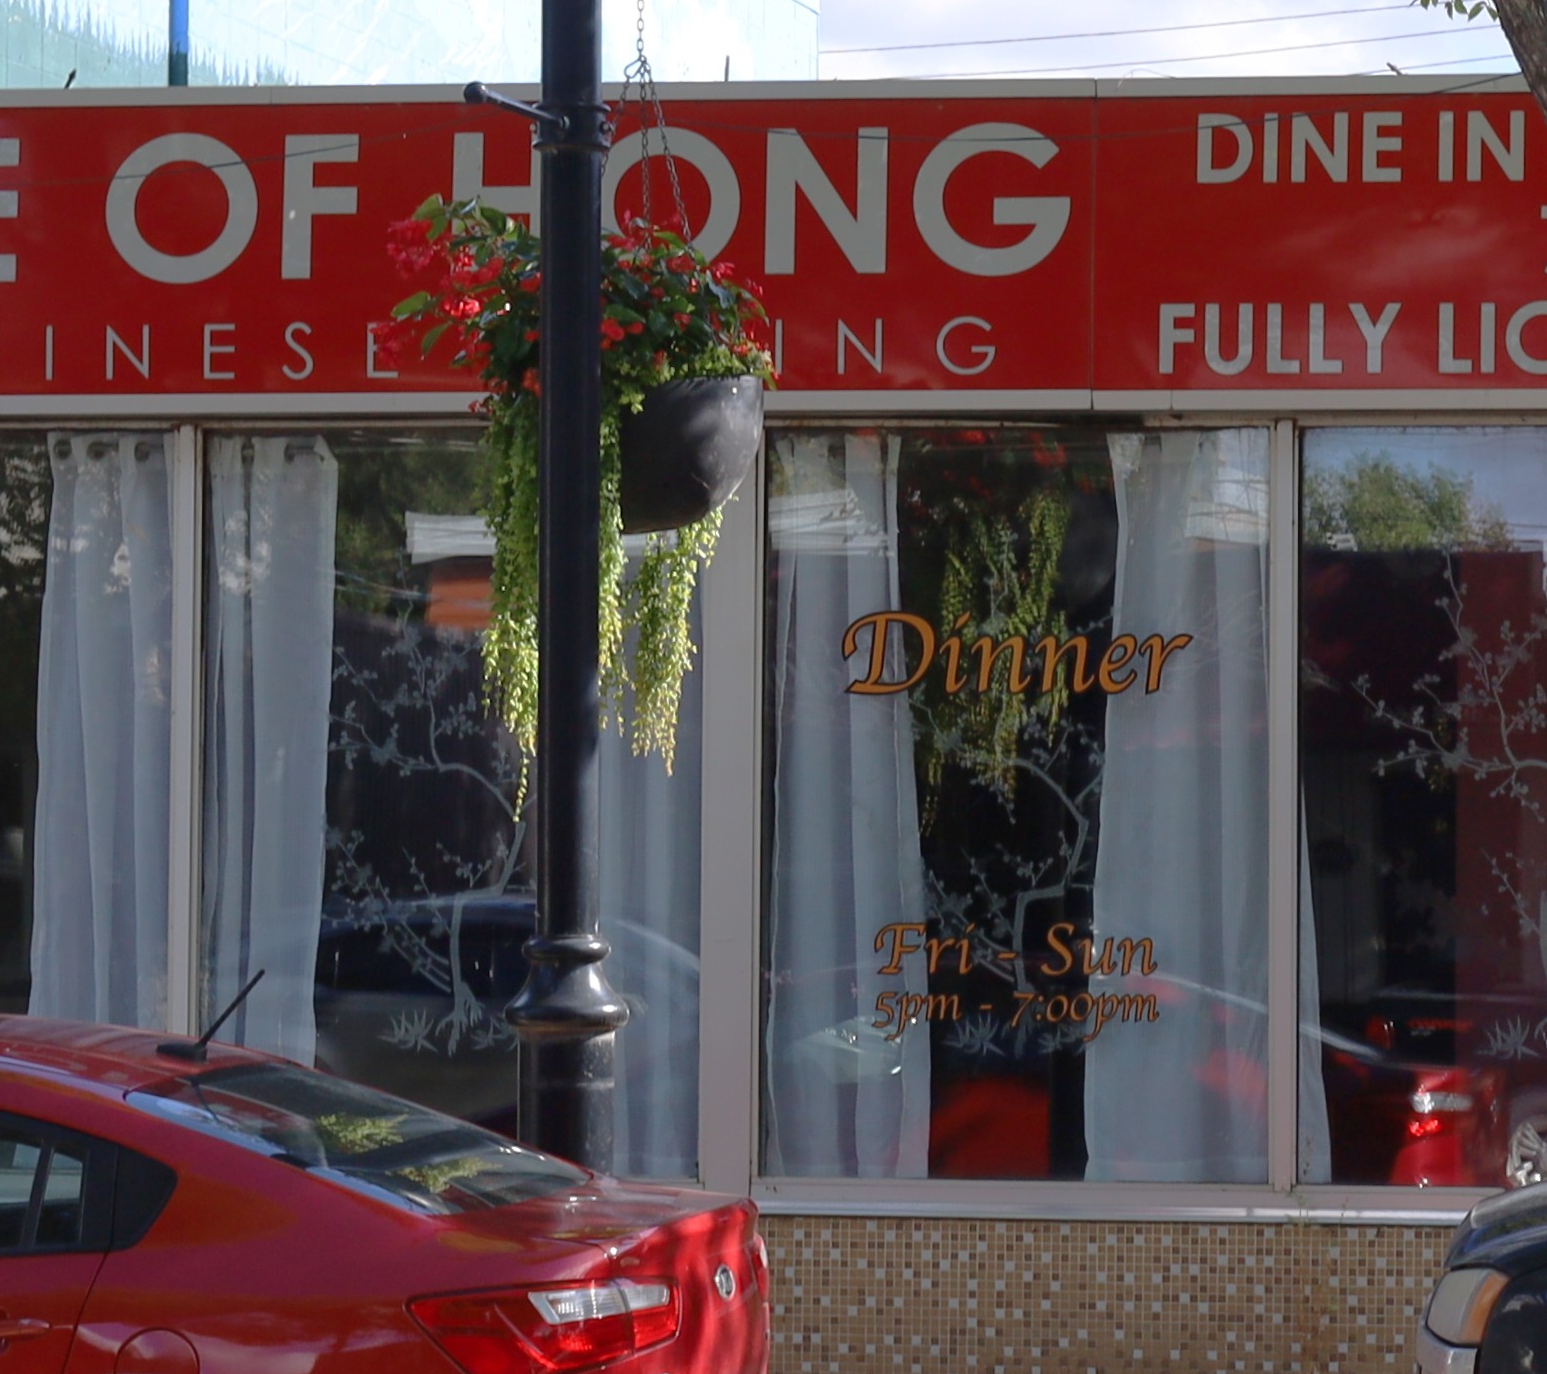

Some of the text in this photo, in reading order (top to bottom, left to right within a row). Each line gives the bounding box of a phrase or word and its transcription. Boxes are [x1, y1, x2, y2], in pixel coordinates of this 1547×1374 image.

[1195, 110, 1403, 185] DINE
[1437, 109, 1526, 183] IN
[105, 132, 360, 286] OF
[1157, 301, 1402, 376] FULLY
[841, 609, 1194, 696] Dinner
[873, 921, 976, 976] Fri
[1040, 922, 1158, 976] Sun
[871, 991, 963, 1042] 5pm
[1010, 991, 1161, 1043] 7:00pm
